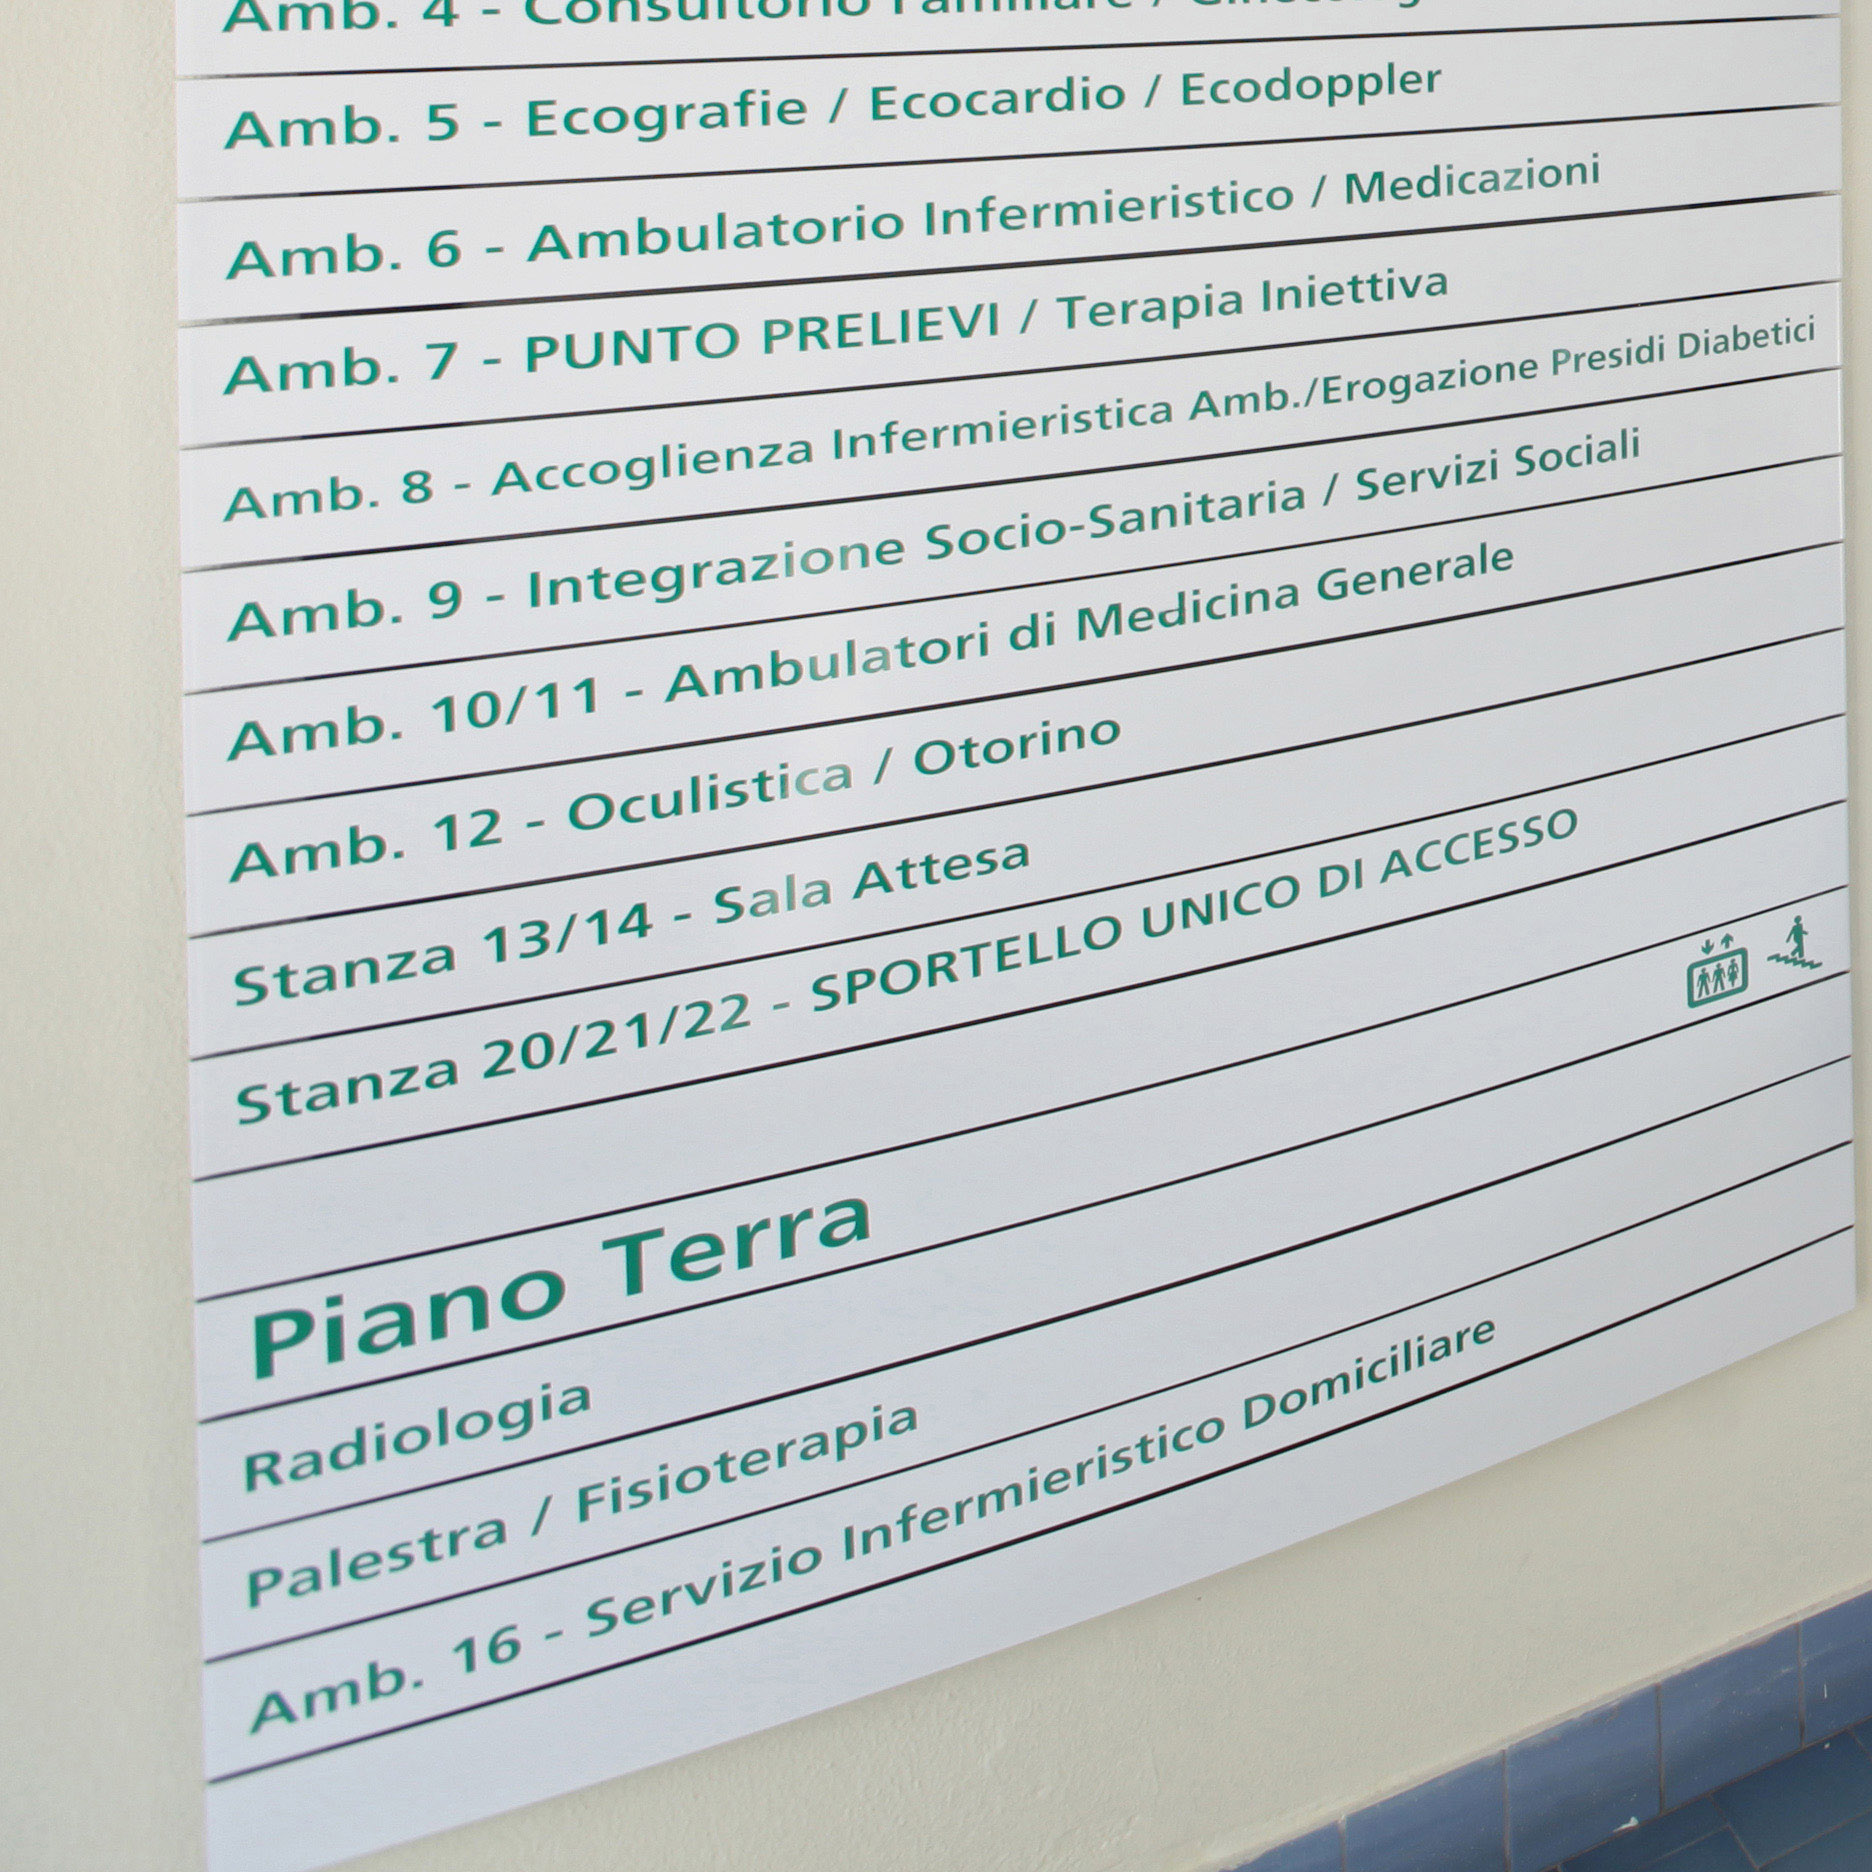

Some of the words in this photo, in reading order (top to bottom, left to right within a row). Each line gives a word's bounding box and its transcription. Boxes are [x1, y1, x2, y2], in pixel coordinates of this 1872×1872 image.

[220, 475, 376, 523] Amb.
[398, 470, 431, 506] 8
[487, 441, 811, 497] Accoglienza
[830, 400, 1171, 461] Infermieristica
[1186, 359, 1538, 421] Amb./Erogazione
[1550, 336, 1665, 377] Presidi
[1677, 314, 1818, 361] Diabetici
[233, 1060, 456, 1128] Stanza
[479, 992, 749, 1081] 20/21/22
[808, 917, 1120, 1014] SPORTELLO
[1139, 876, 1299, 940] UNICO
[1317, 859, 1362, 899] DI
[1377, 807, 1577, 885] ACCESSO
[250, 1271, 564, 1383] Piano
[598, 1200, 870, 1299] Terra
[240, 1384, 591, 1497] Radiologia
[245, 1519, 505, 1611] Palestra
[574, 1406, 916, 1526] Fisioterapia
[245, 1662, 422, 1738] Amb.
[449, 1626, 519, 1675] 16
[583, 1547, 821, 1640] Servizio
[840, 1410, 1224, 1563] Infermieristico
[1240, 1322, 1495, 1432] Domiciliare
